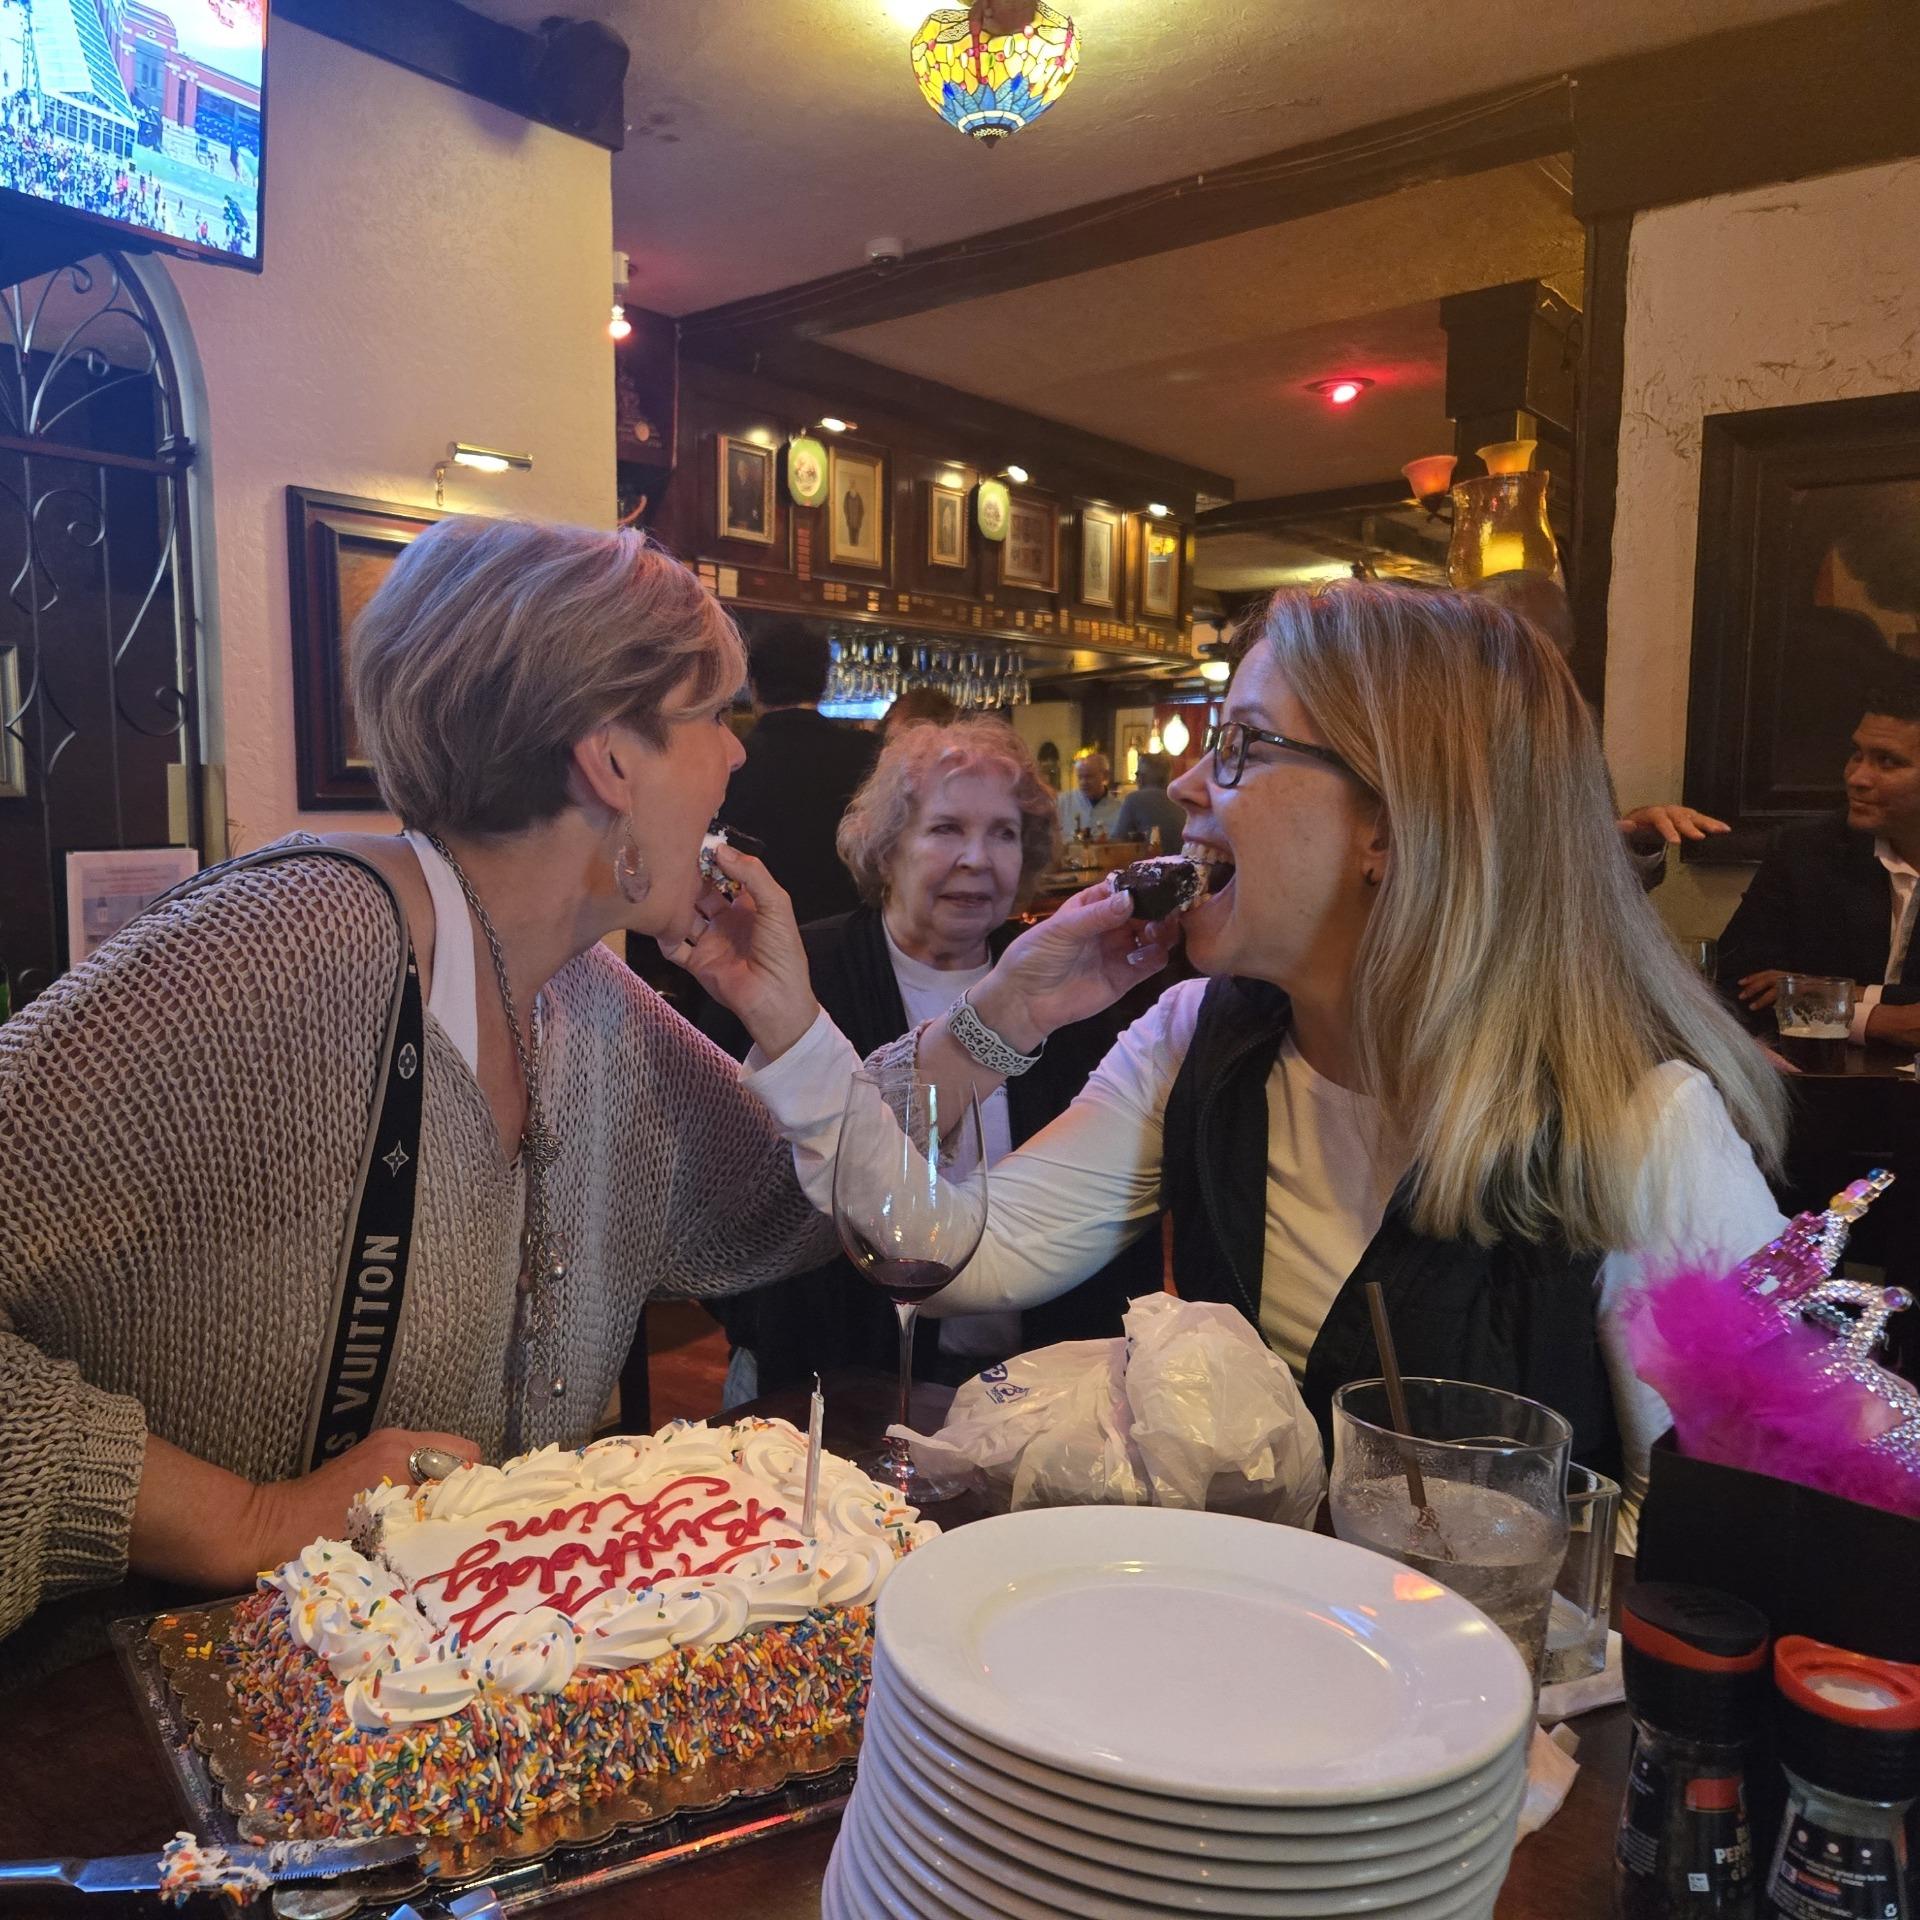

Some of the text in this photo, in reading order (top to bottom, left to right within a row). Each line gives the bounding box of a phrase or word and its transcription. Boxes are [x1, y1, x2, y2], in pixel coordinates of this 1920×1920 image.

[332, 1235, 399, 1414] VUITTON
[390, 1498, 786, 1601] Birthday
[485, 1475, 731, 1543] Kim
